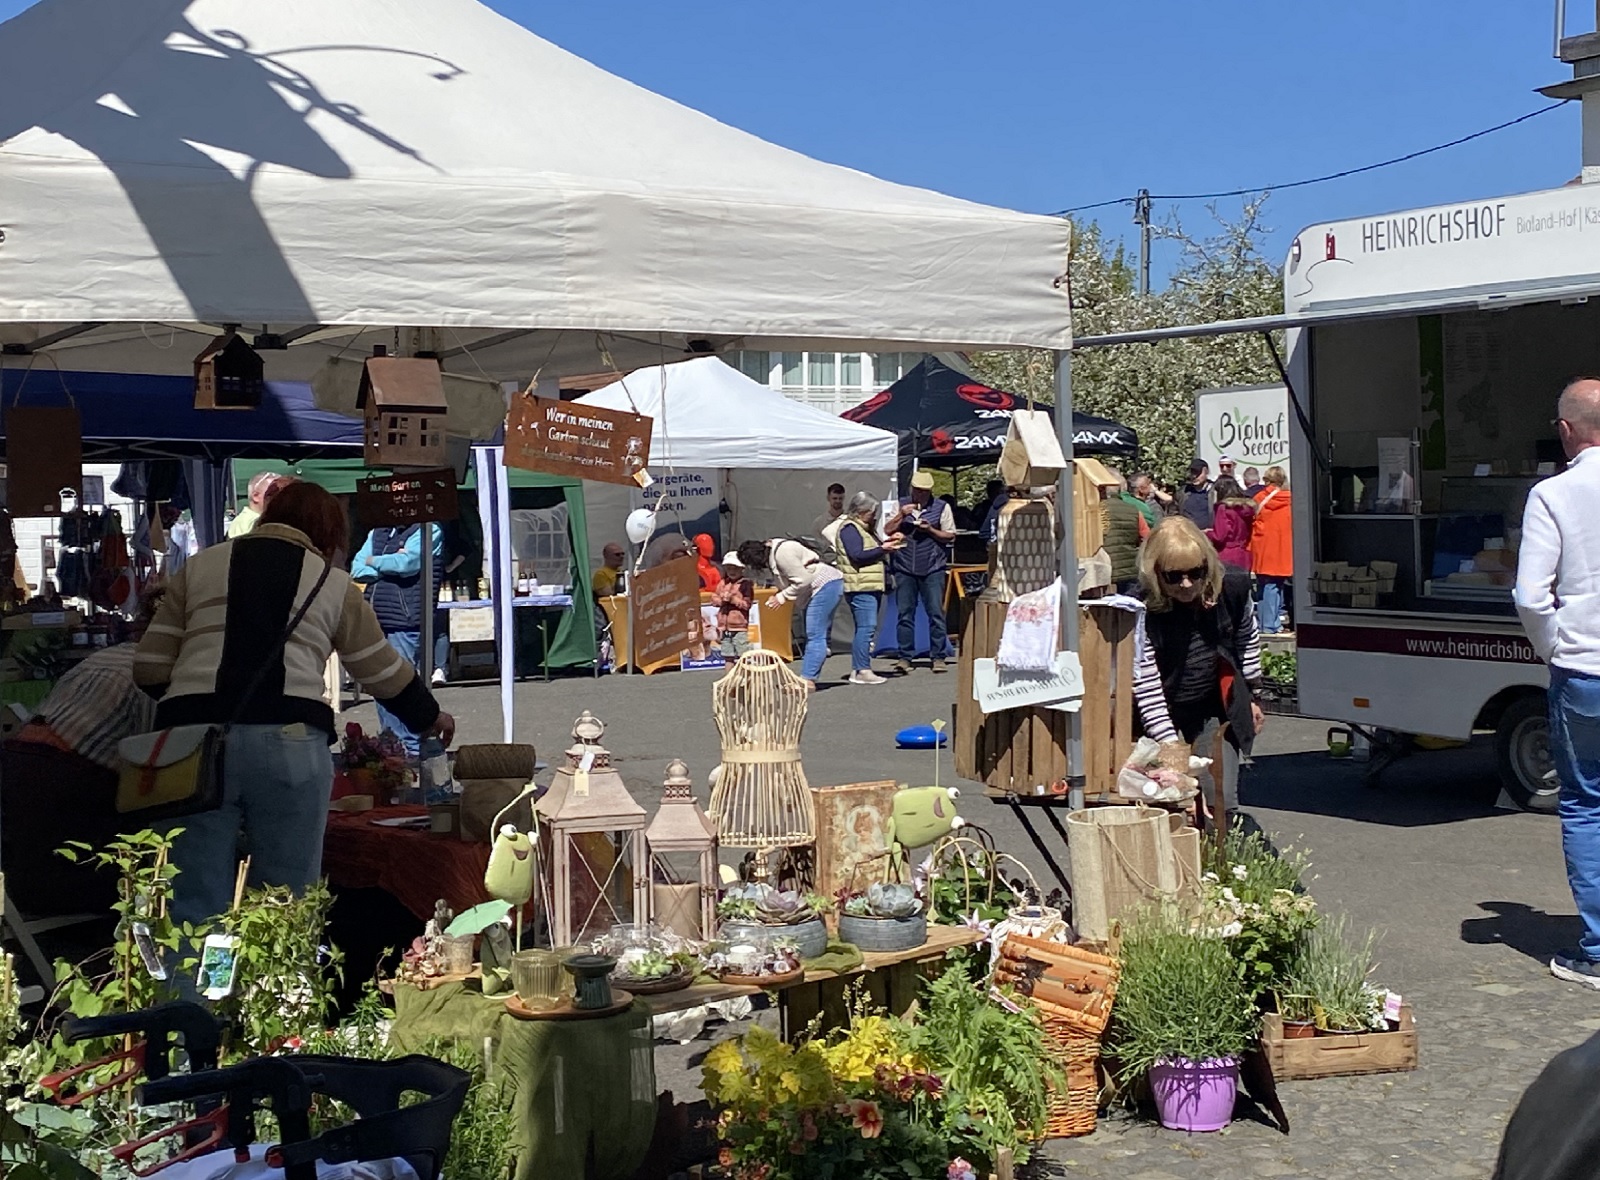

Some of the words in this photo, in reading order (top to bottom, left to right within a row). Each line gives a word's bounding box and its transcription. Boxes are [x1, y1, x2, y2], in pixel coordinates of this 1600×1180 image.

[1362, 204, 1505, 253] HEINRICHSHOF
[546, 407, 566, 423] Wer
[578, 415, 614, 432] meinen
[974, 409, 1014, 419] 24
[548, 427, 579, 443] Garten
[1219, 412, 1285, 448] Biohof
[954, 434, 1007, 449] 24M
[1072, 431, 1124, 445] 4MX
[1243, 436, 1288, 464] Seeger
[652, 474, 704, 486] örgeräte,
[370, 483, 390, 493] Mein
[643, 486, 661, 498] die
[680, 486, 713, 497] Ihnen
